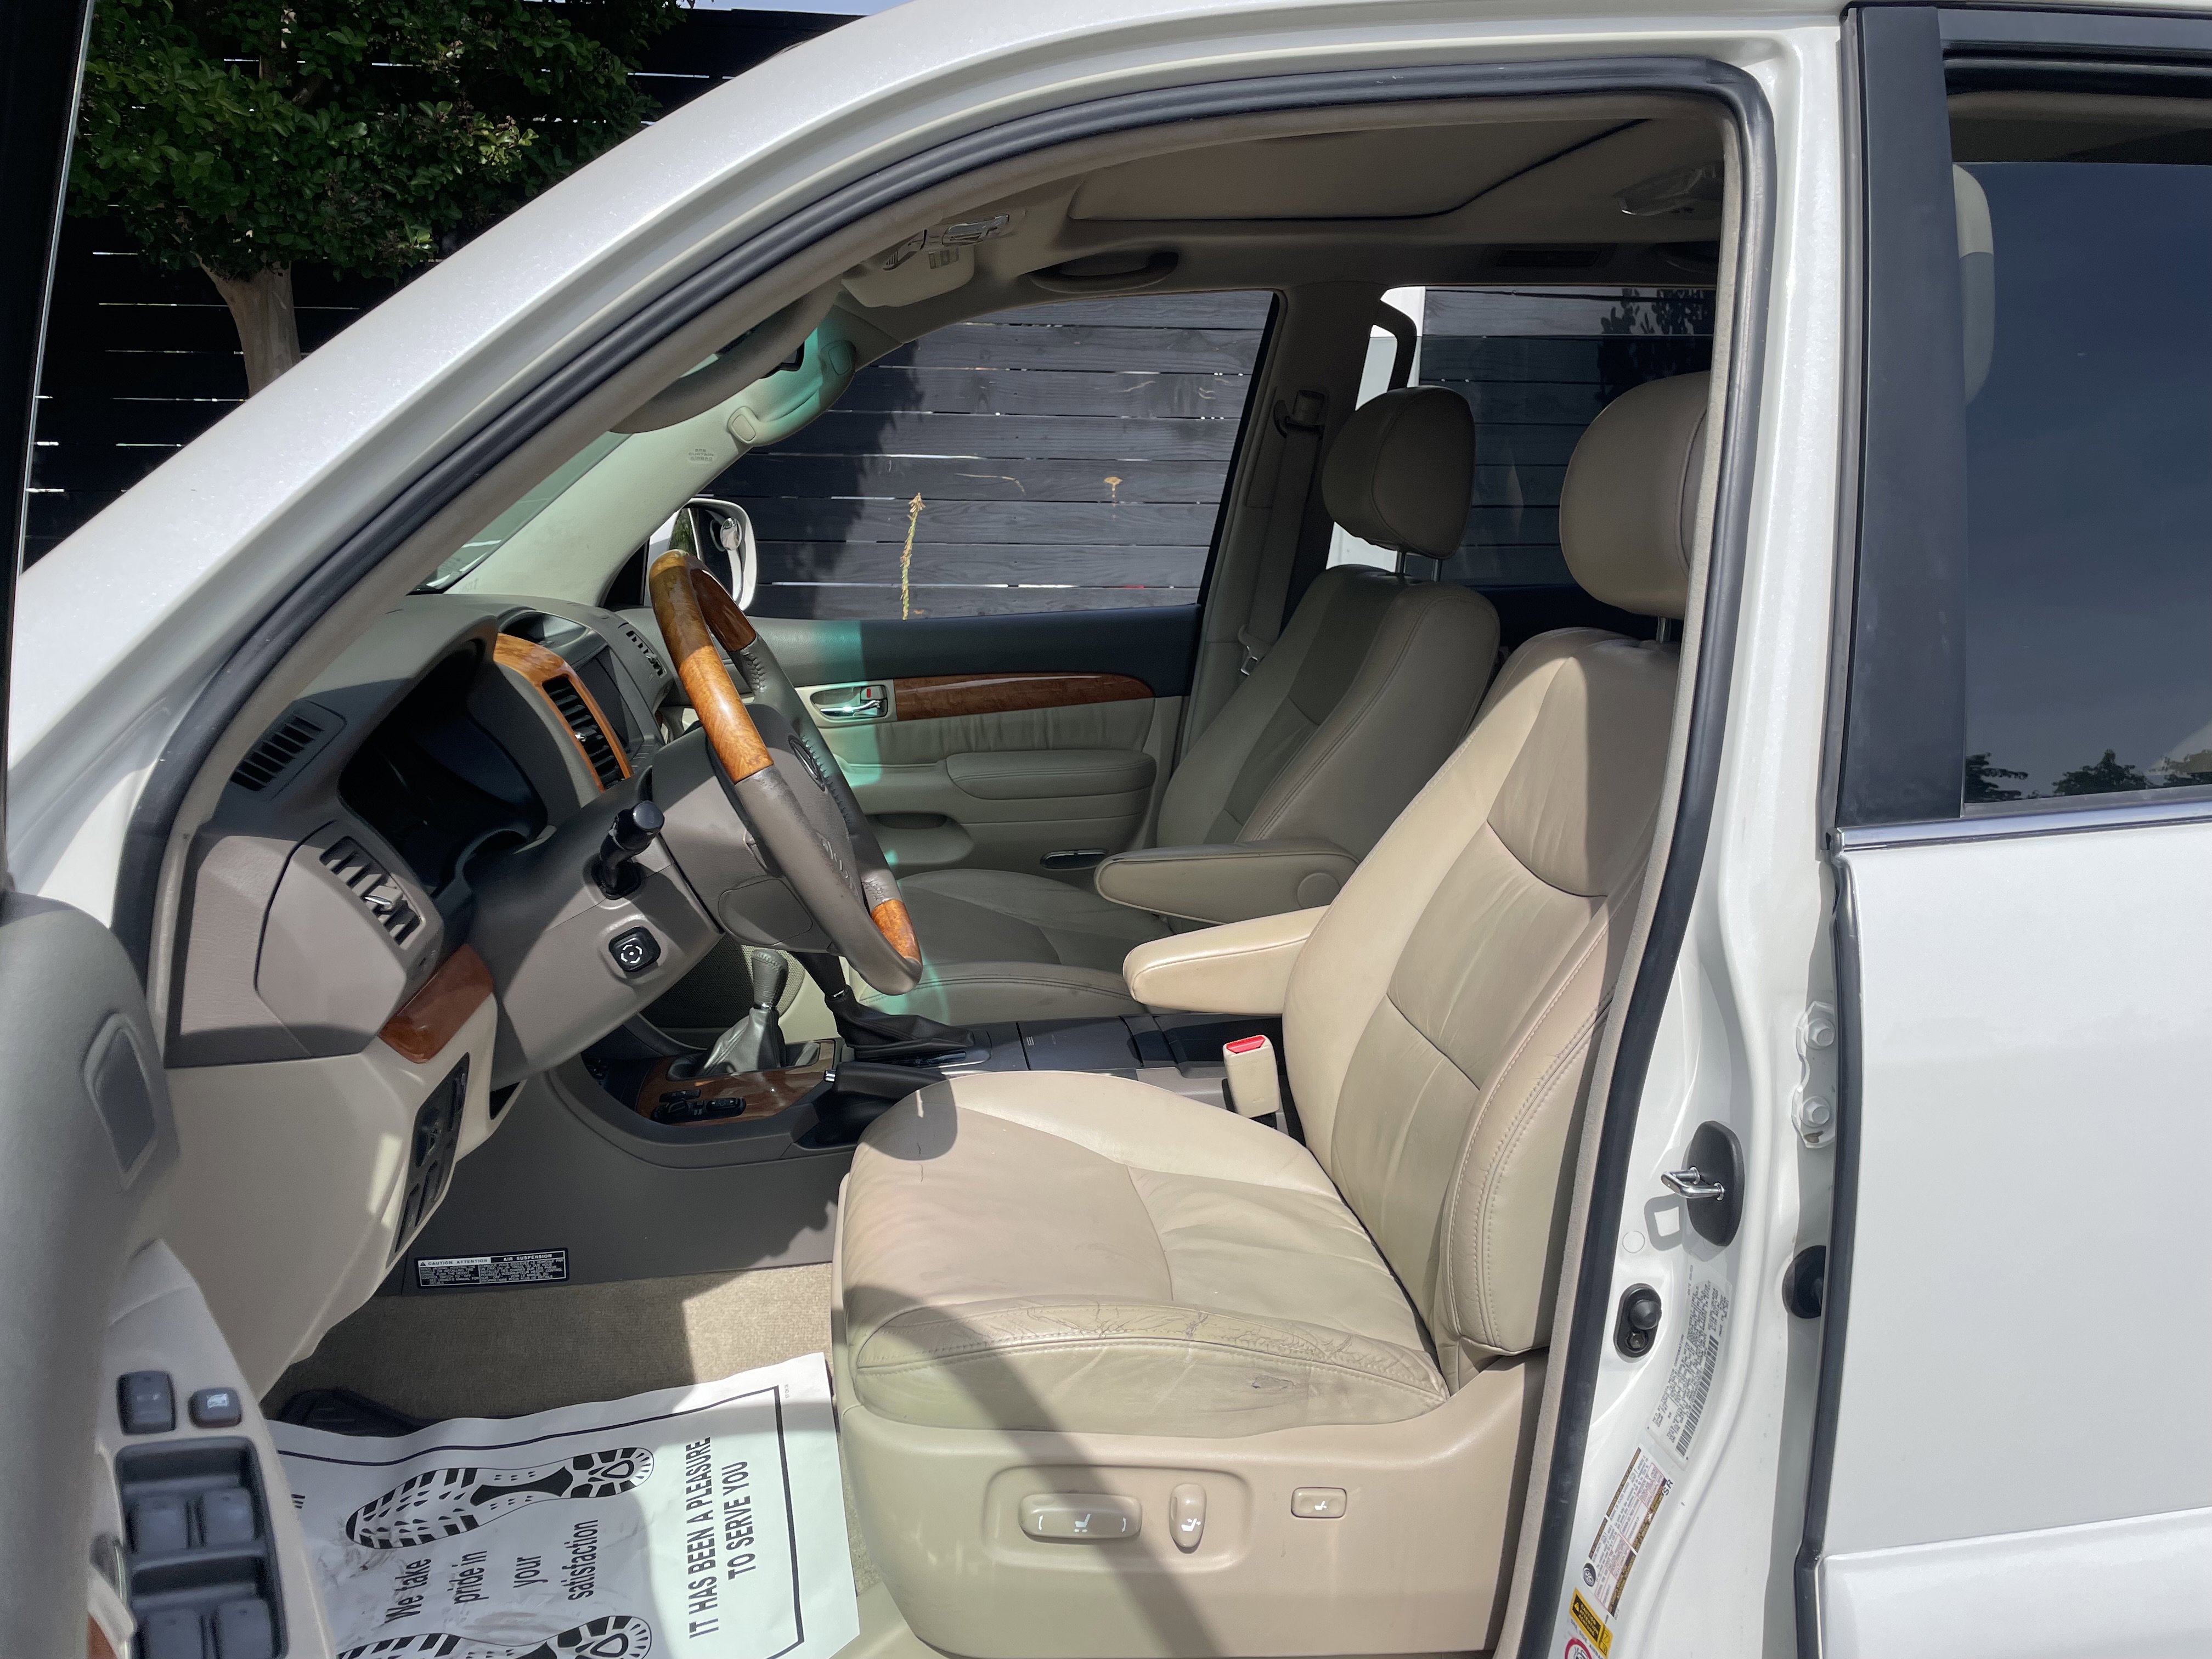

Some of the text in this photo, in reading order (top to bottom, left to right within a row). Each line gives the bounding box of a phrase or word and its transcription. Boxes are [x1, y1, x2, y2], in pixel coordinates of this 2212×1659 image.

[686, 1437, 719, 1639] IT HAS BEEN A PLEASURE
[721, 1462, 756, 1581] TO SERVE YOU
[383, 1559, 431, 1624] We take
[447, 1550, 489, 1604] pride in
[513, 1556, 548, 1588] your
[561, 1520, 599, 1600] satisfaction
